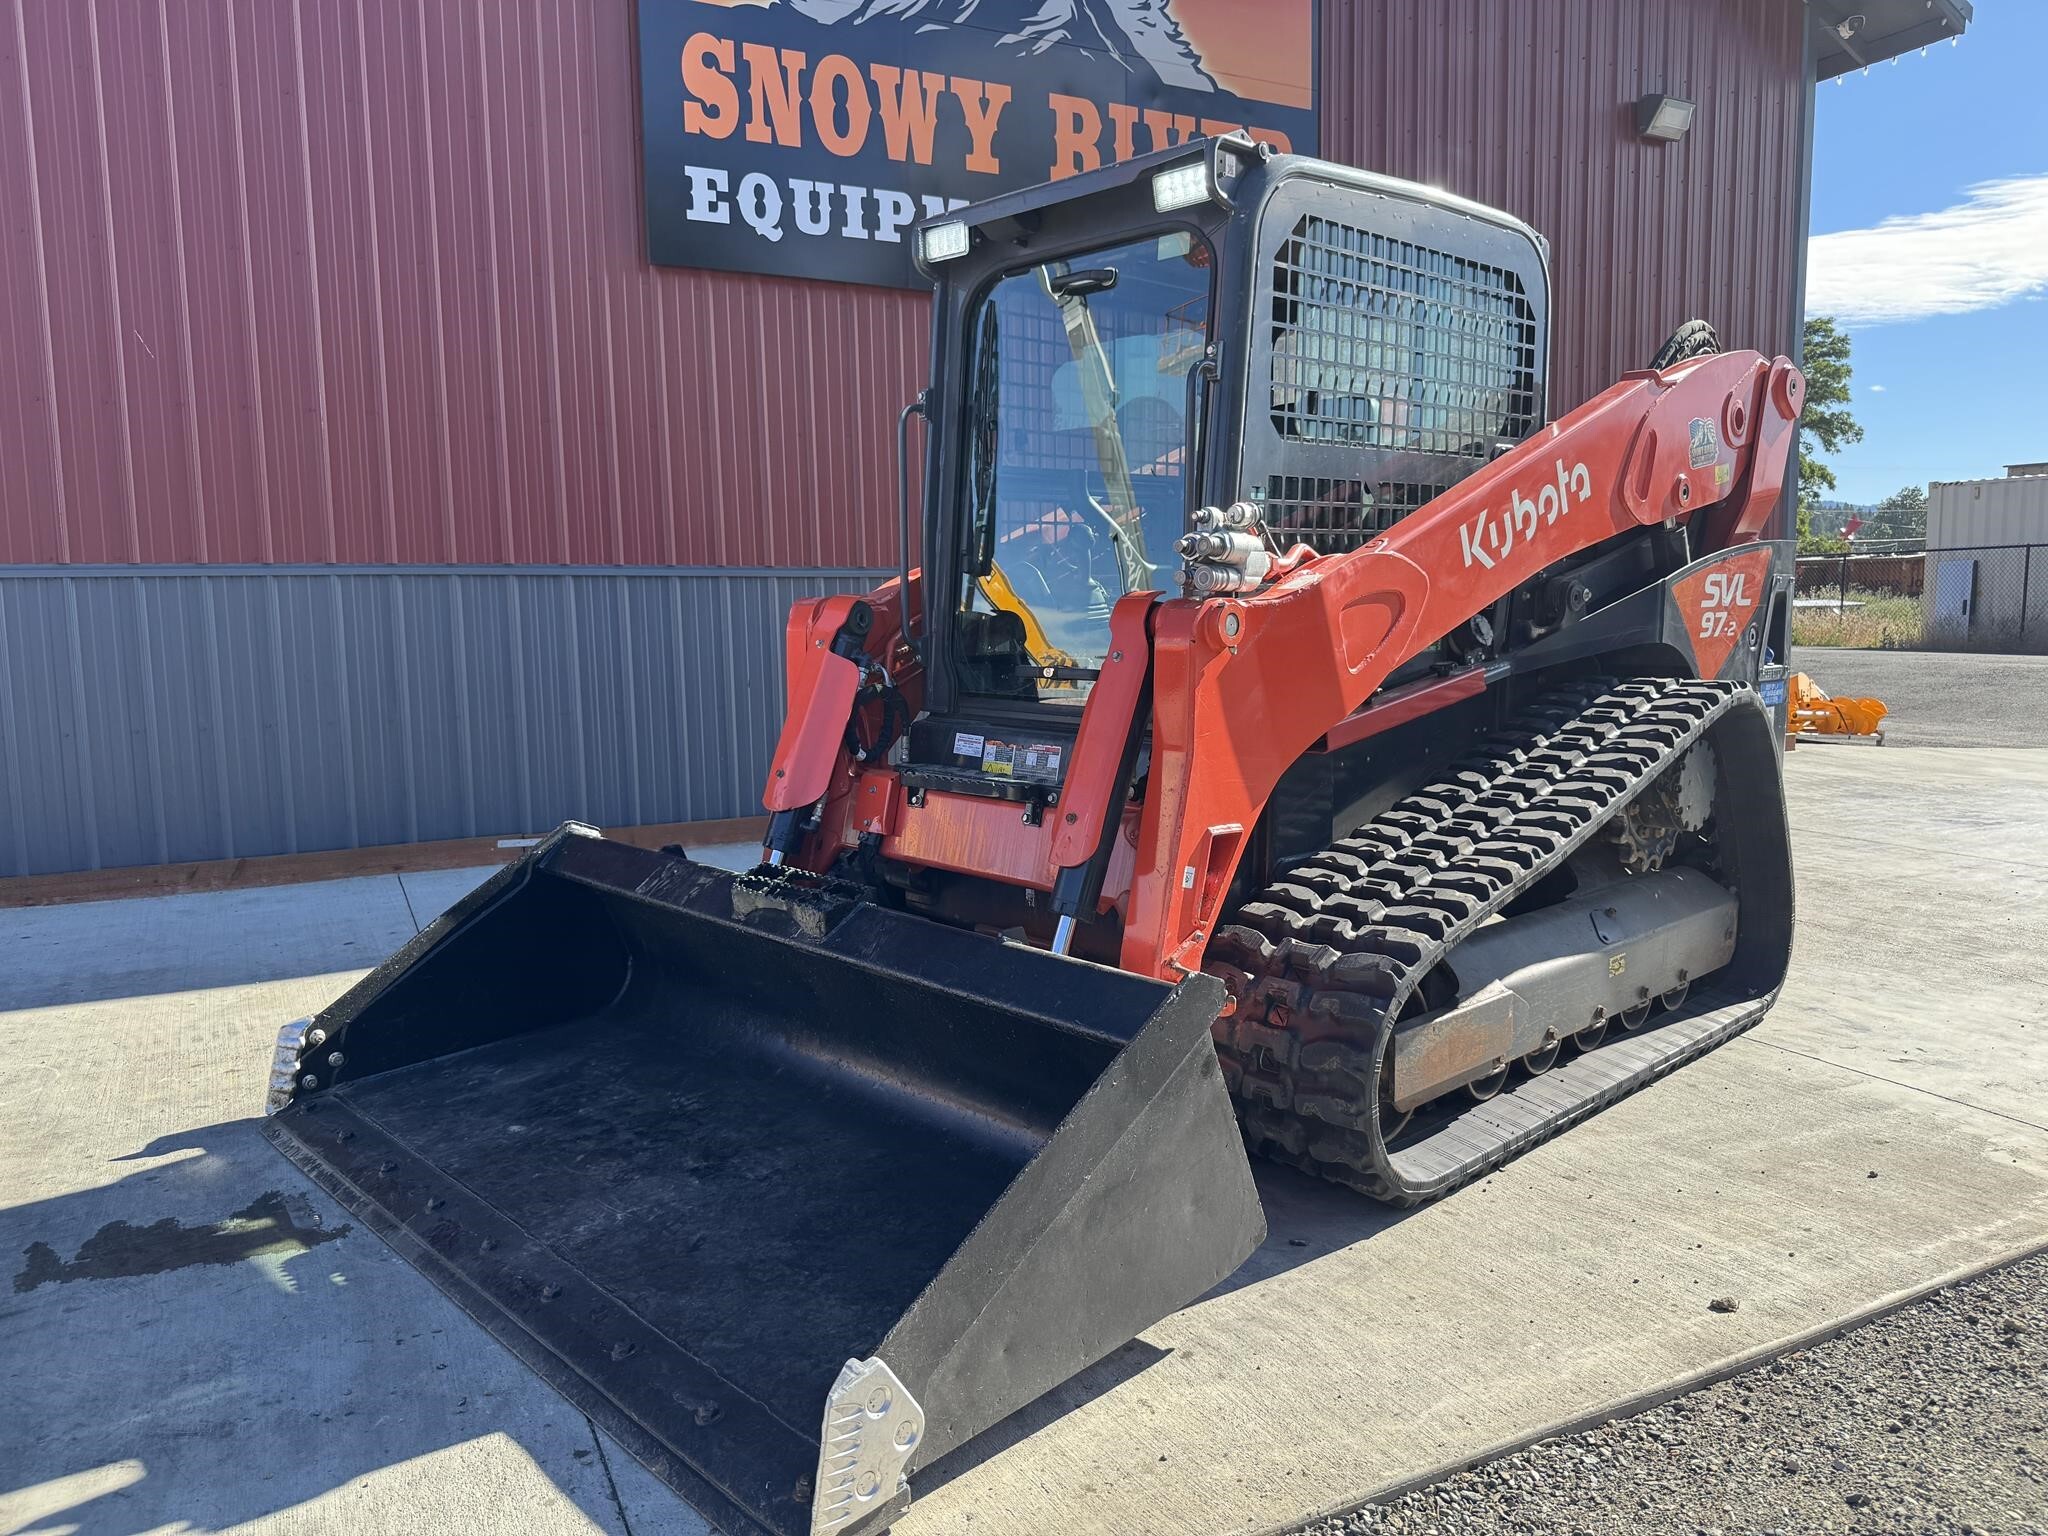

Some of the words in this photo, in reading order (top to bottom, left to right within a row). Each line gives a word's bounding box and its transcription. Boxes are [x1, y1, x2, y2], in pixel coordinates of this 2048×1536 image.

[681, 32, 1012, 175] SNOWY
[1049, 91, 1293, 183] RIV
[684, 165, 970, 243] EQUIP
[1459, 458, 1591, 570] Kubota
[1699, 611, 1737, 638] 97-2
[1700, 573, 1752, 608] SVL
